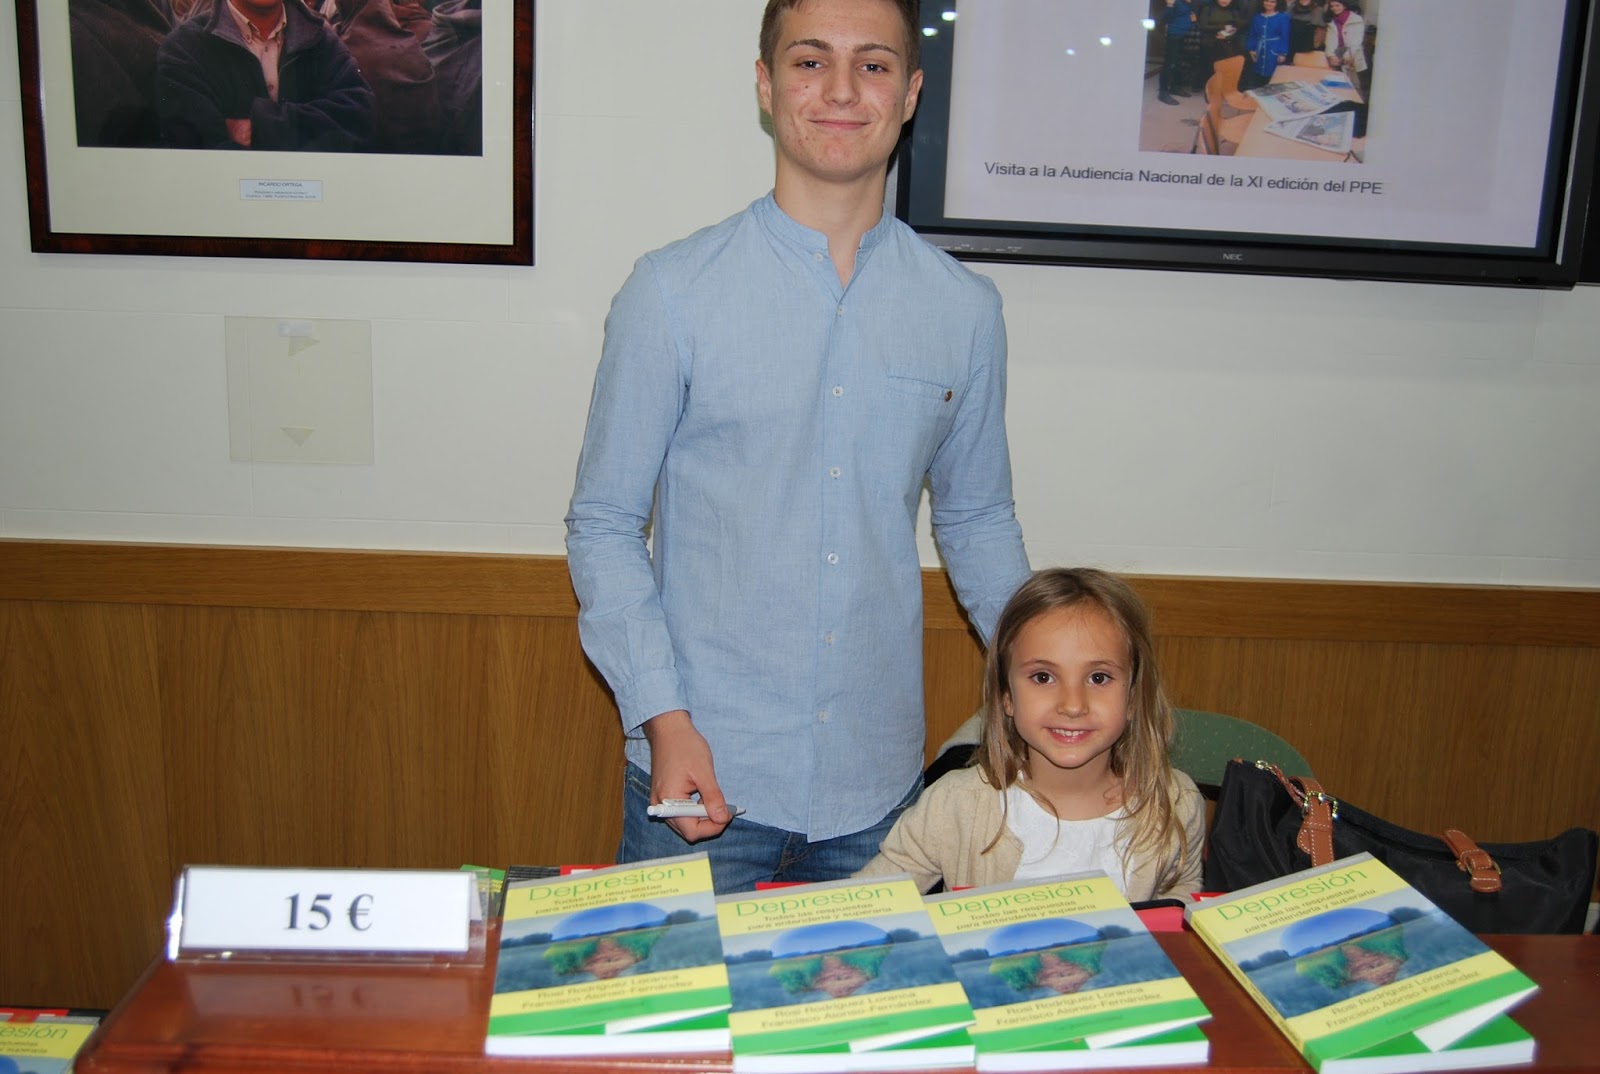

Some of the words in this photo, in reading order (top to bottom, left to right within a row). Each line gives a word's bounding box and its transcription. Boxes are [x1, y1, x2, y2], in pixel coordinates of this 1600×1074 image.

[984, 162, 1025, 176] Visita
[1029, 166, 1039, 177] a
[1043, 165, 1056, 178] la
[1060, 166, 1134, 182] Audiencia
[1139, 169, 1203, 185] Nacional
[1206, 173, 1225, 186] de
[1230, 174, 1243, 187] la
[1247, 175, 1263, 188] XI
[1267, 177, 1319, 191] edición
[1323, 180, 1345, 193] del
[1349, 181, 1384, 195] PPE
[1222, 253, 1243, 261] NEC
[528, 867, 685, 901] Depresión
[938, 883, 1095, 917] Depresión
[1217, 870, 1367, 921] Depresión
[283, 893, 334, 931] 15
[346, 893, 375, 932] €
[736, 886, 893, 917] Depresión
[1243, 922, 1267, 934] para
[1331, 888, 1376, 906] superarla
[1253, 909, 1284, 922] Todas
[1286, 904, 1300, 913] las
[1302, 888, 1355, 908] respuestas
[0, 1024, 69, 1039] esión
